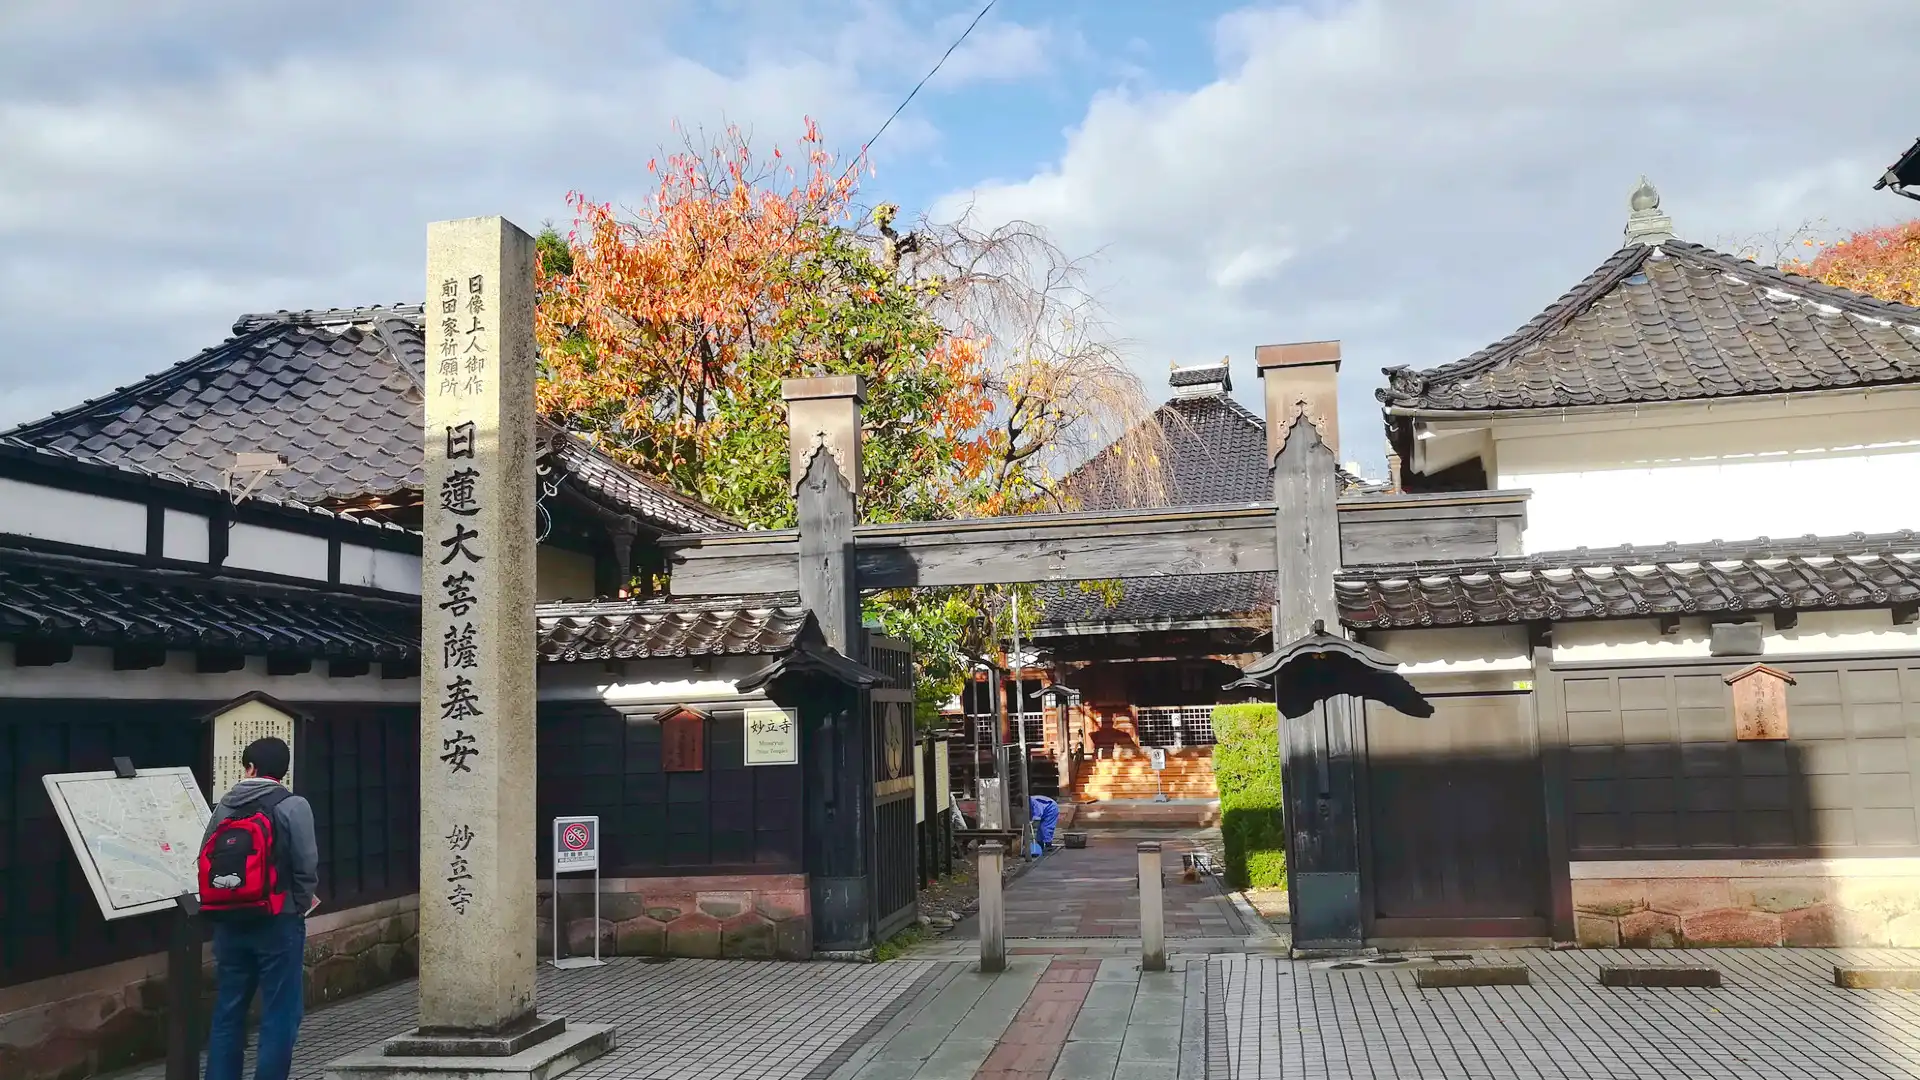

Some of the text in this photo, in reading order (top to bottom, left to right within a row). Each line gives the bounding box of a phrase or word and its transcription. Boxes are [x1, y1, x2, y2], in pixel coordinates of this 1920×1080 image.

[439, 278, 460, 397] 前田家祈願所
[463, 274, 487, 395] 日像上人御作
[439, 420, 484, 774] 日蓮大菩薩奉安
[751, 718, 792, 735] 妙立寺
[445, 823, 475, 916] 妙立寺
